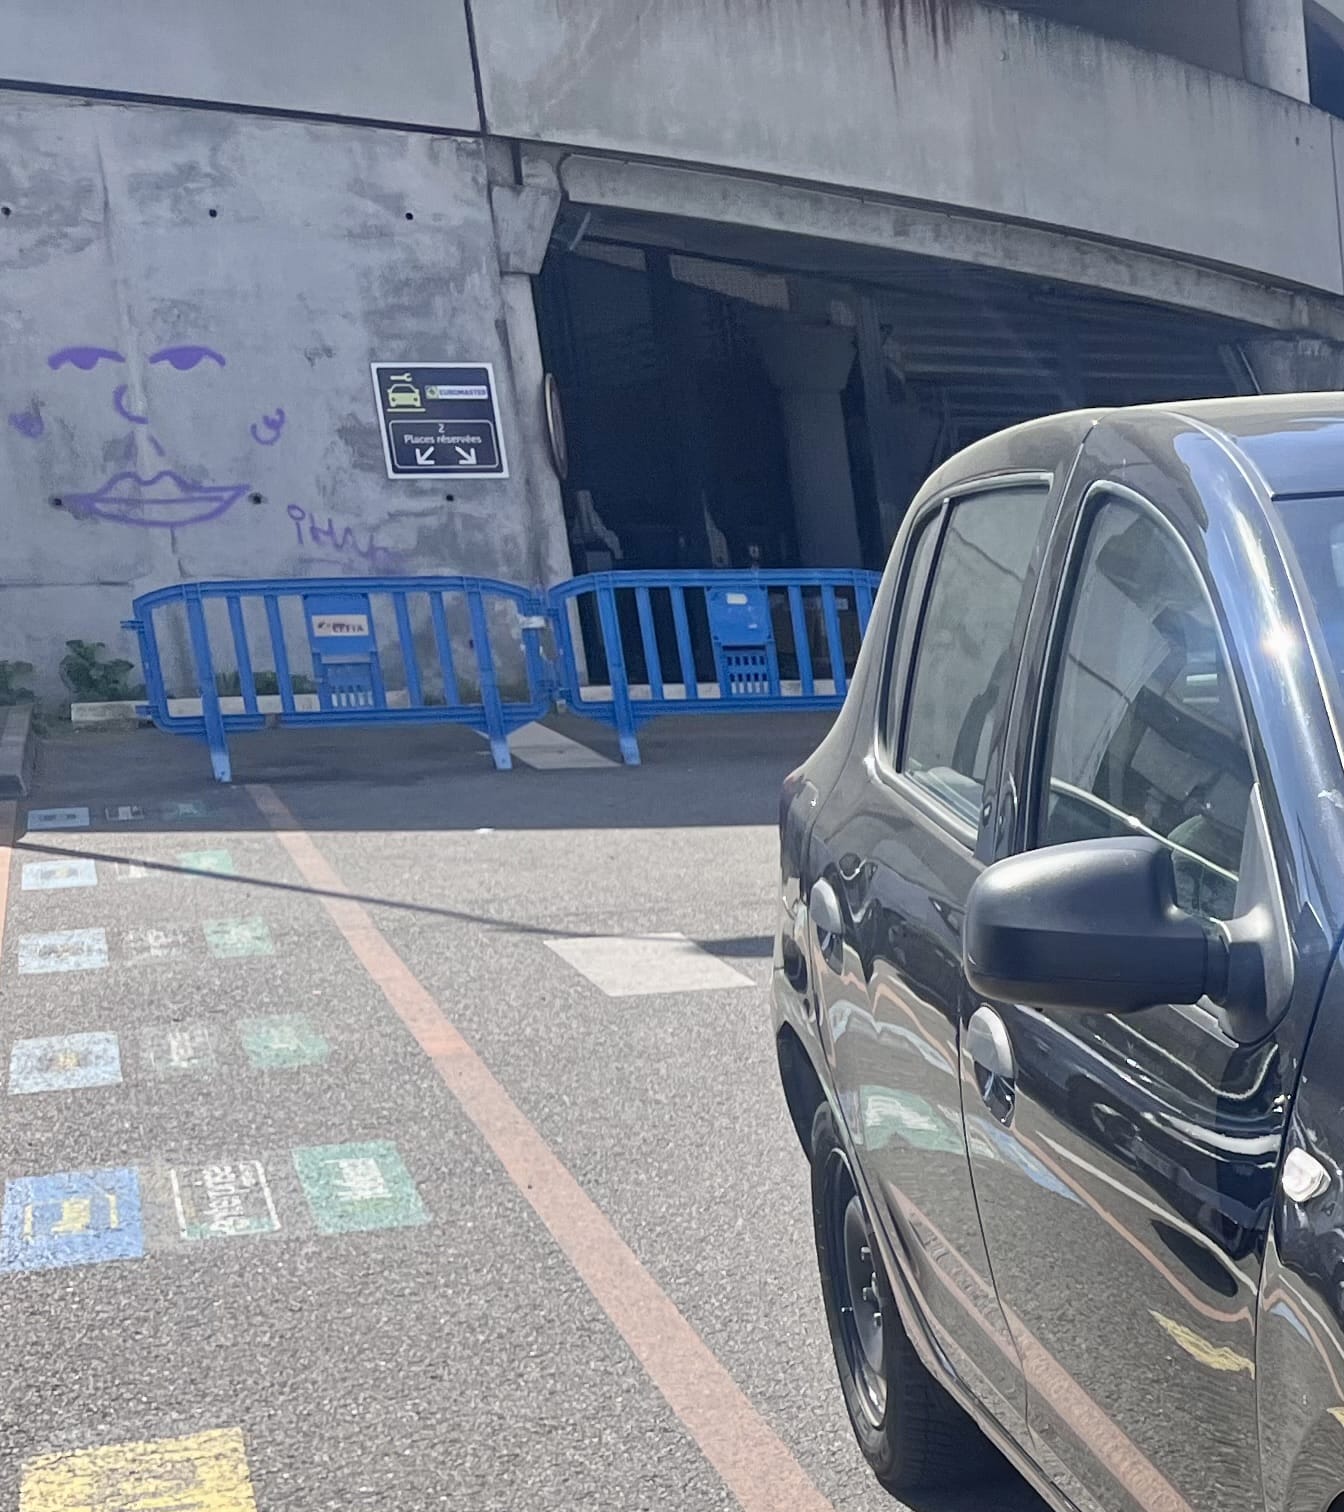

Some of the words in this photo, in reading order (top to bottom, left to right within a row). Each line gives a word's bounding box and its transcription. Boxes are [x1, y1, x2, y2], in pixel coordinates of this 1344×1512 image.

[438, 423, 445, 433] 2
[404, 434, 435, 444] Places
[437, 434, 482, 444] réservées
